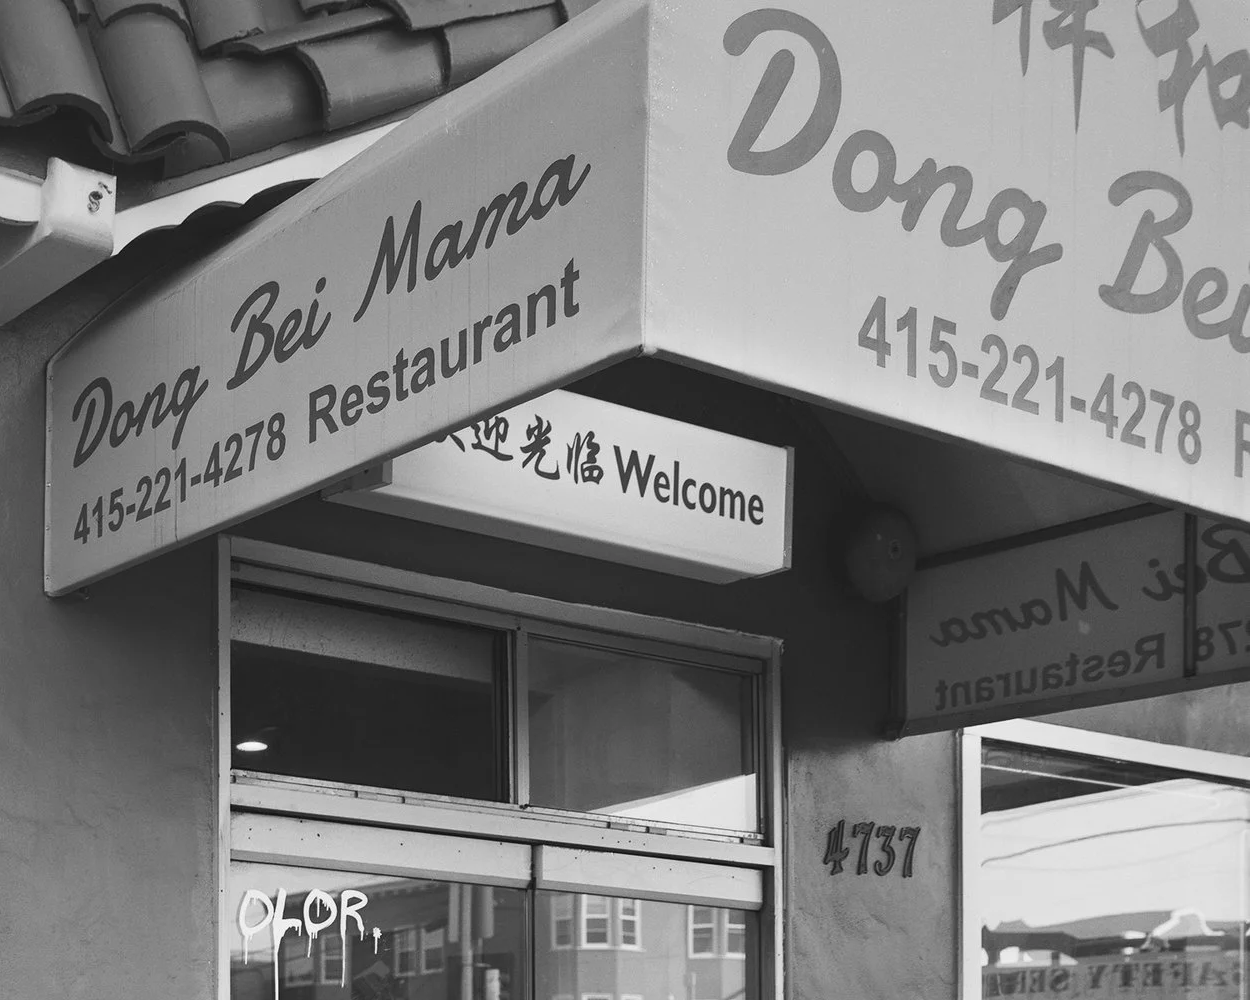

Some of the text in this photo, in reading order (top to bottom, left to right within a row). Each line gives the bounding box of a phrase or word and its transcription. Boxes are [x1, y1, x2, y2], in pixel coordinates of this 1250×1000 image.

[723, 8, 1063, 321] Dong
[71, 153, 592, 468] Dong Bei Mama
[73, 257, 580, 544] 415-221-4278 Restaurant
[857, 295, 1202, 465] 415-221-4278
[613, 445, 764, 525] Welcome
[823, 819, 921, 878] 4737
